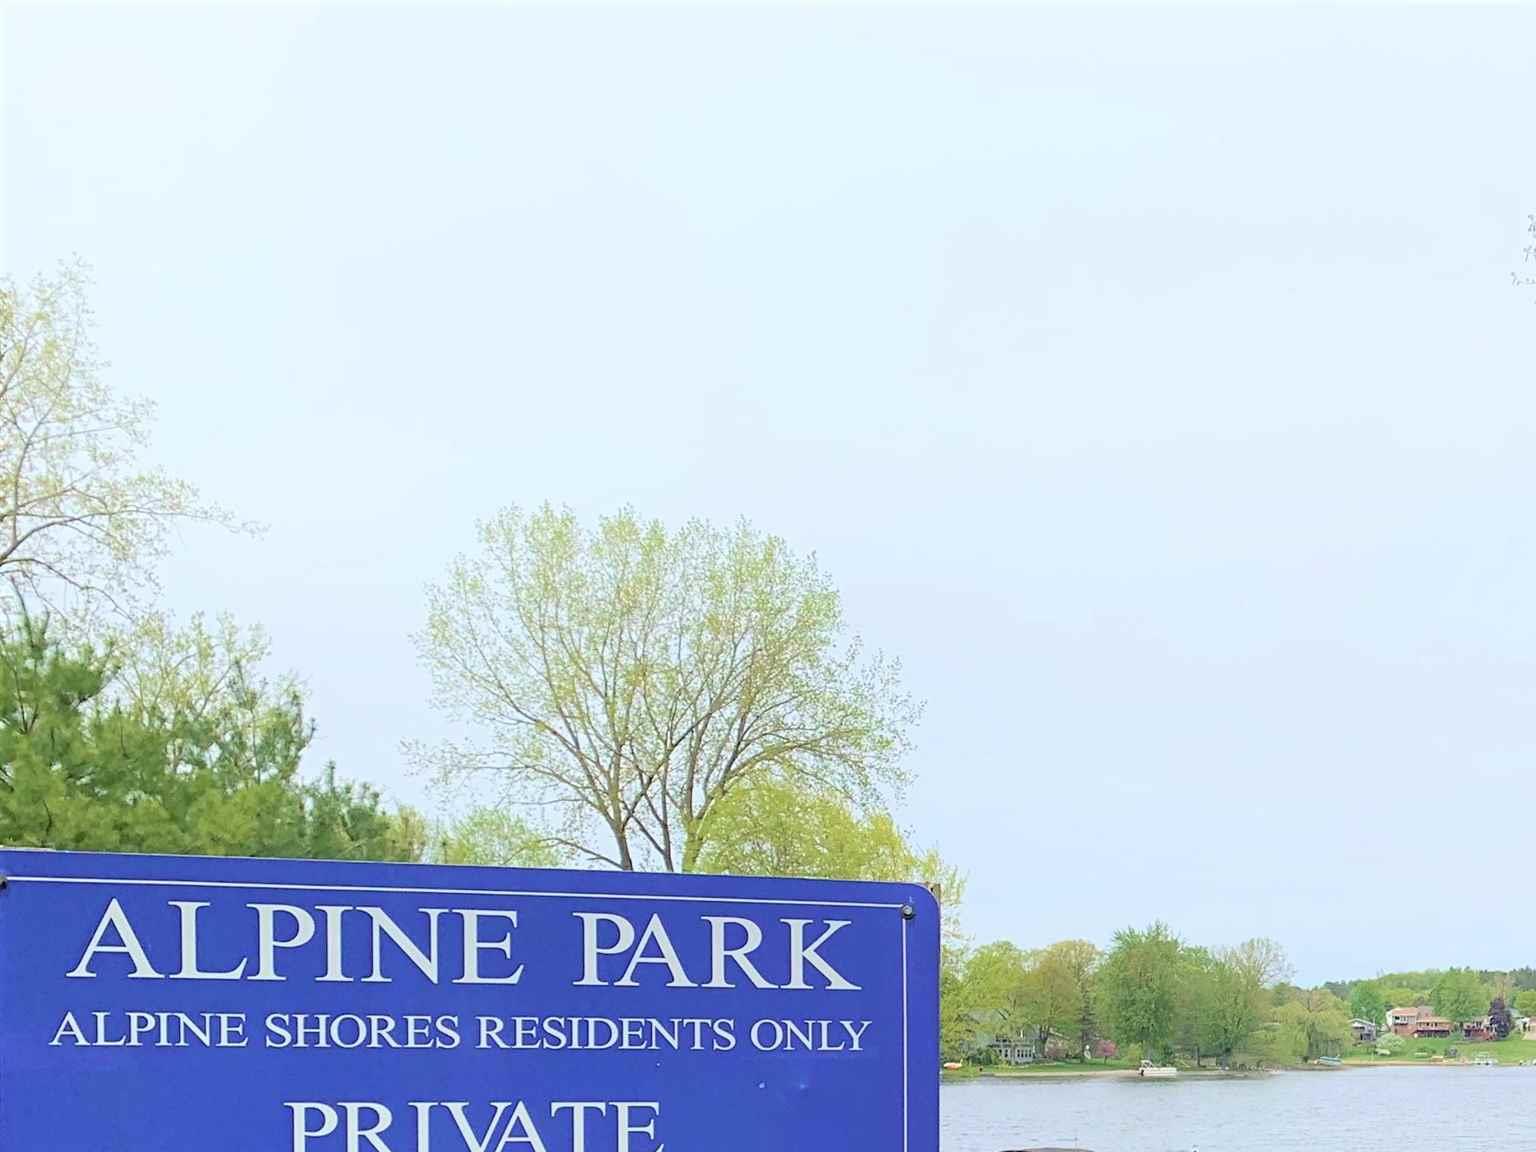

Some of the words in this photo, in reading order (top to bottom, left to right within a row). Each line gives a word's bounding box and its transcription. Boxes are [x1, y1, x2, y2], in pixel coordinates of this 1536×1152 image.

[66, 899, 523, 983] ALPINE
[573, 913, 861, 989] PARK
[49, 1012, 248, 1046] ALPINE
[266, 1014, 460, 1048] SHORES
[476, 1017, 735, 1050] RESIDENTS
[751, 1020, 872, 1050] ONLY
